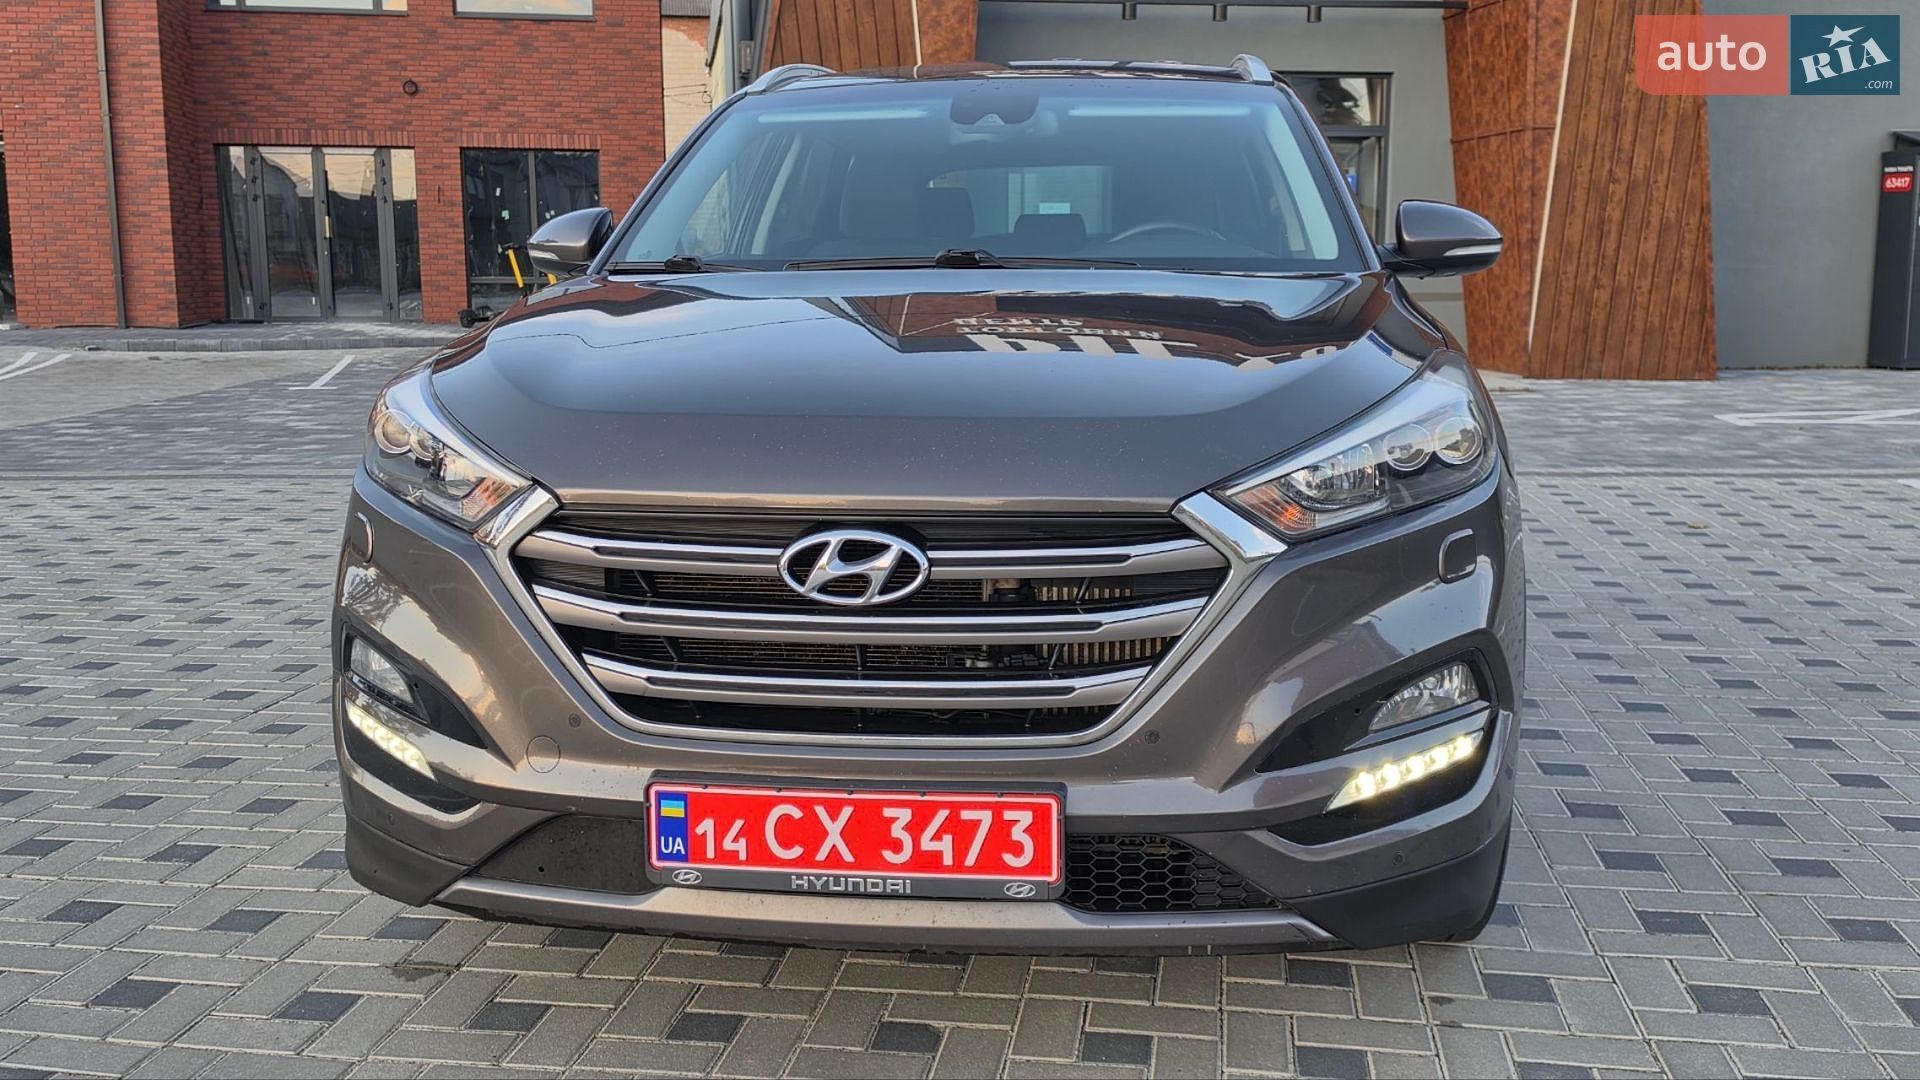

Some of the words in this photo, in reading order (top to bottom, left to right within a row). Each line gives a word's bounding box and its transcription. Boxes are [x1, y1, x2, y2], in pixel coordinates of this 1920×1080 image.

[660, 836, 686, 855] UA
[695, 818, 747, 861] 14
[764, 804, 856, 863] CX
[881, 807, 1035, 868] 3473
[791, 875, 912, 894] HYUNDAI
